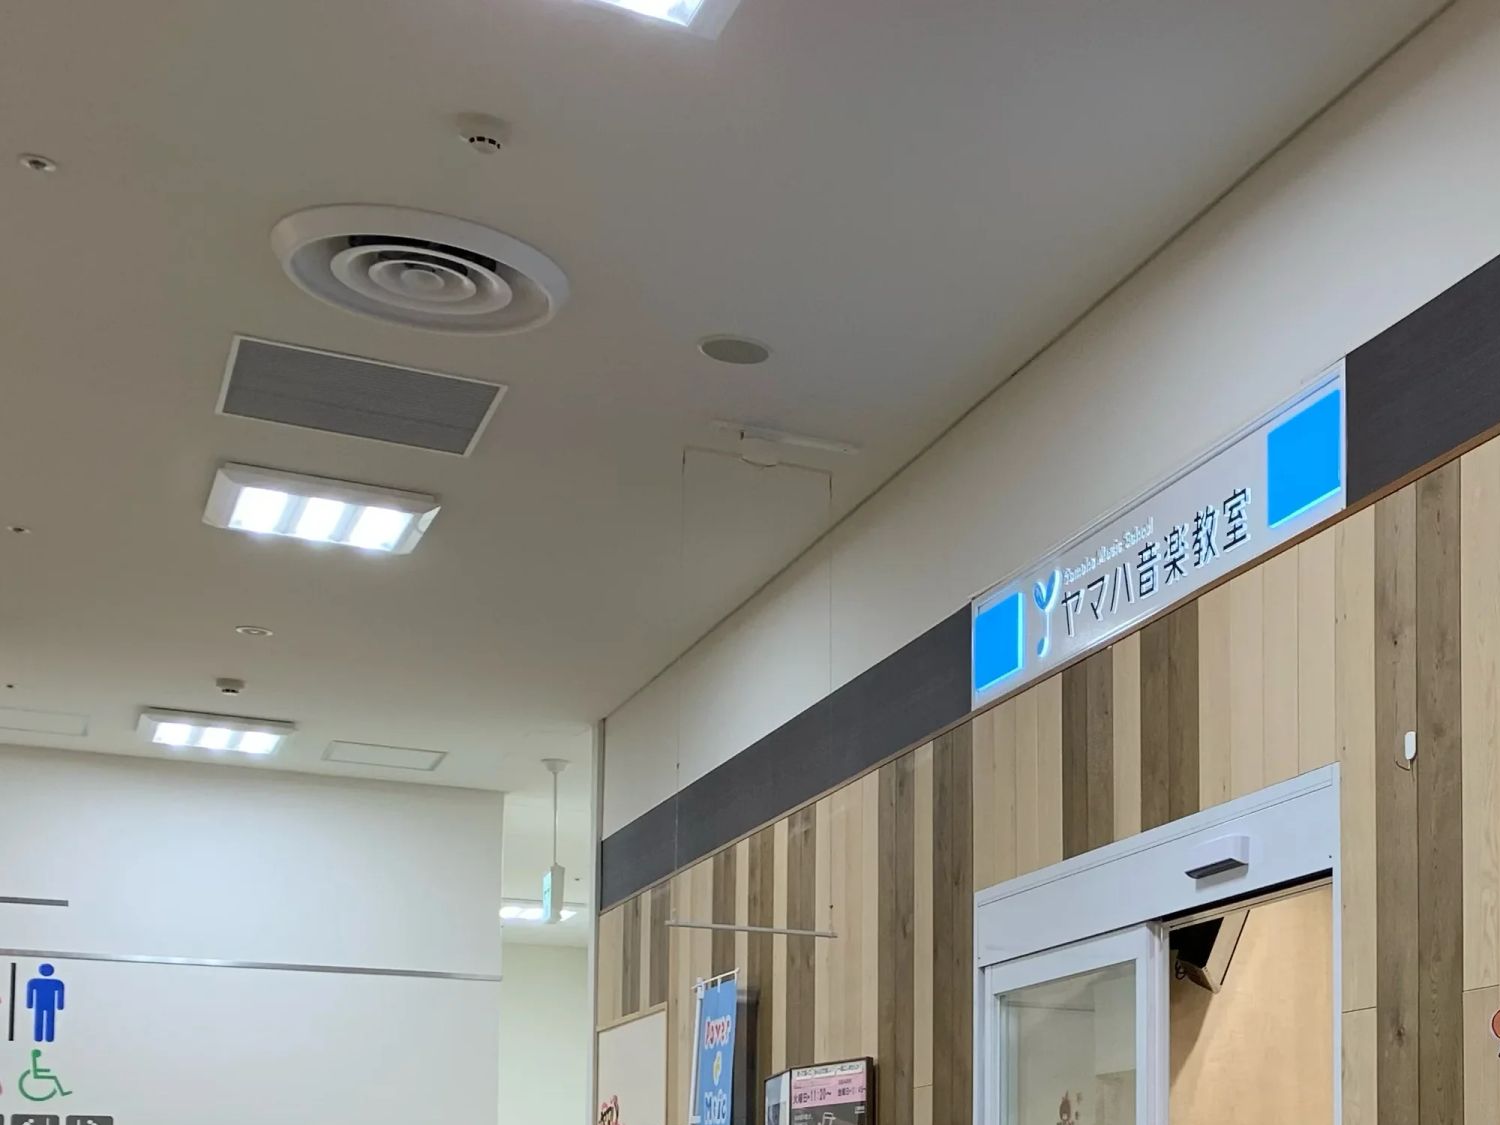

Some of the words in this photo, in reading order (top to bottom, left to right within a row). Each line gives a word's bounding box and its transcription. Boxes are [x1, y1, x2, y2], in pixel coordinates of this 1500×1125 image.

[1060, 487, 1252, 638] ヤマハ音楽教室
[1123, 516, 1154, 549] School
